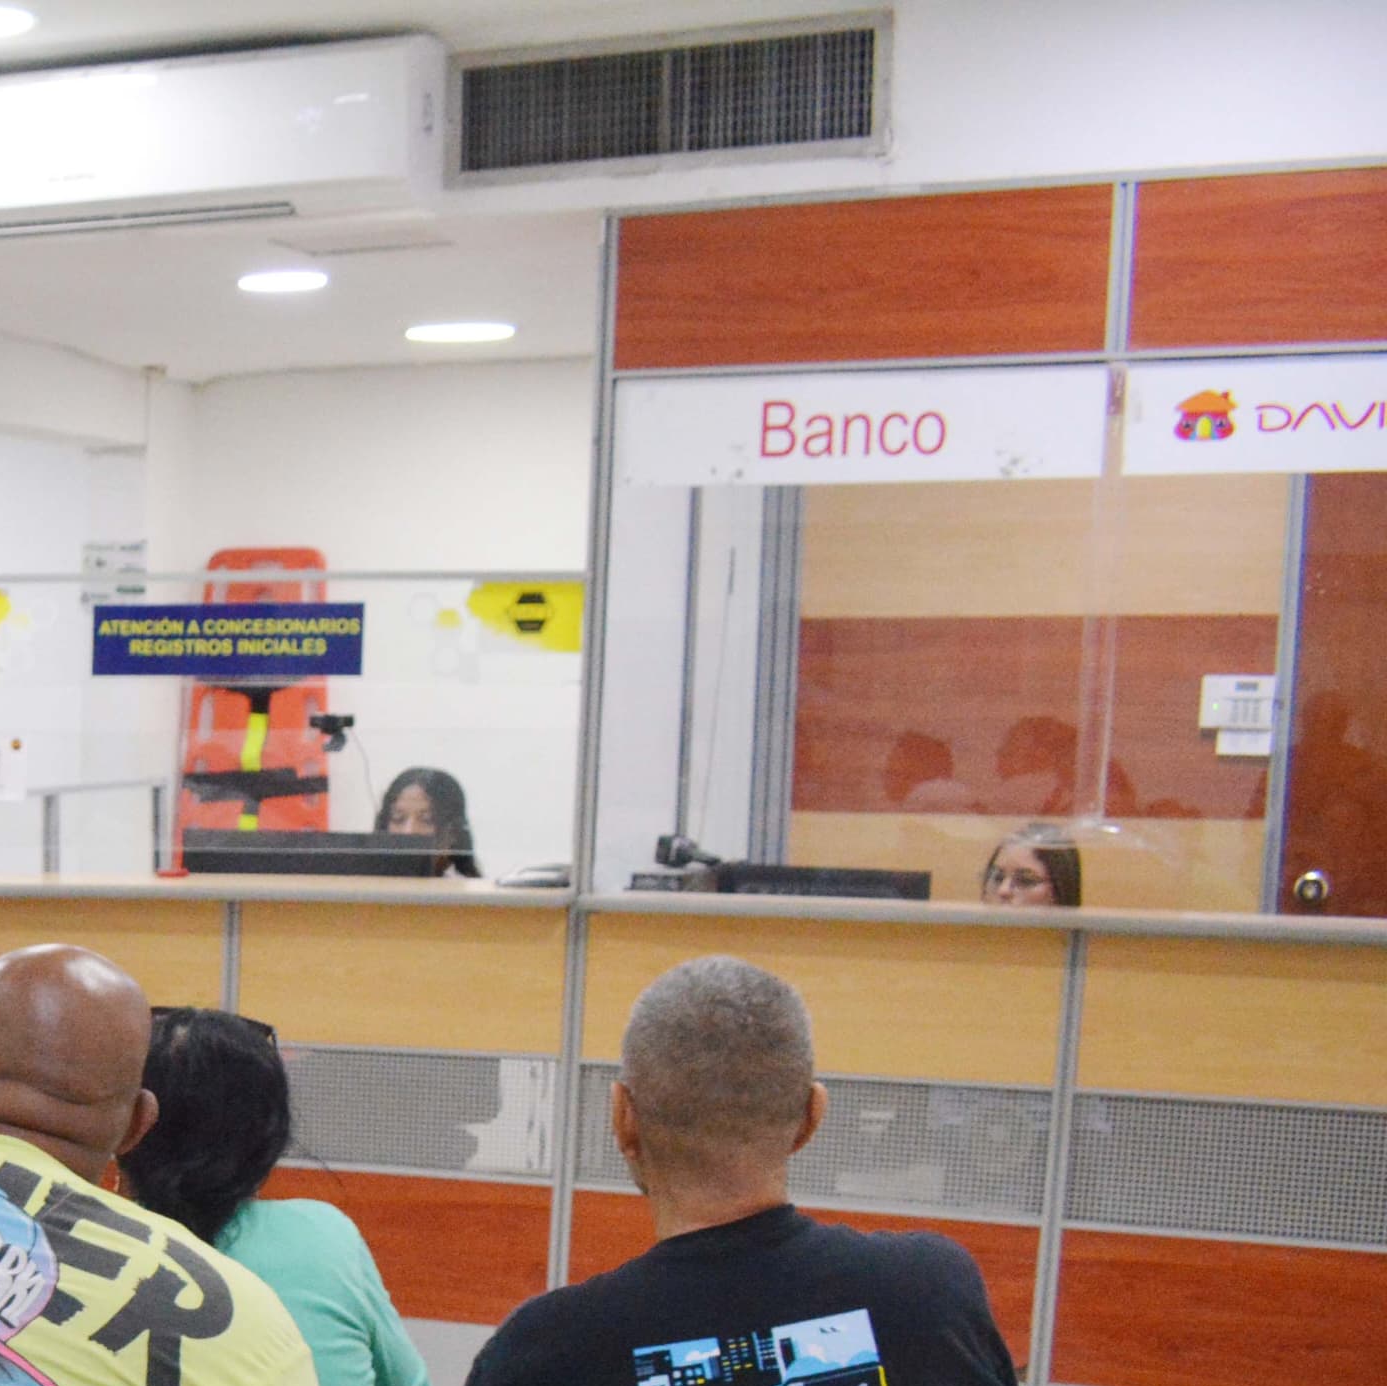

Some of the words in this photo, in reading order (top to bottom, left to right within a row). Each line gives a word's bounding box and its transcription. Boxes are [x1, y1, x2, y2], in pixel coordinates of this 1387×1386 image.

[759, 400, 947, 458] Banco
[98, 617, 185, 637] ATENCIÓN
[186, 619, 201, 635] A
[202, 618, 361, 636] CONCESIONARIOS
[129, 638, 234, 656] REGISTROS
[236, 638, 327, 657] INICIALES
